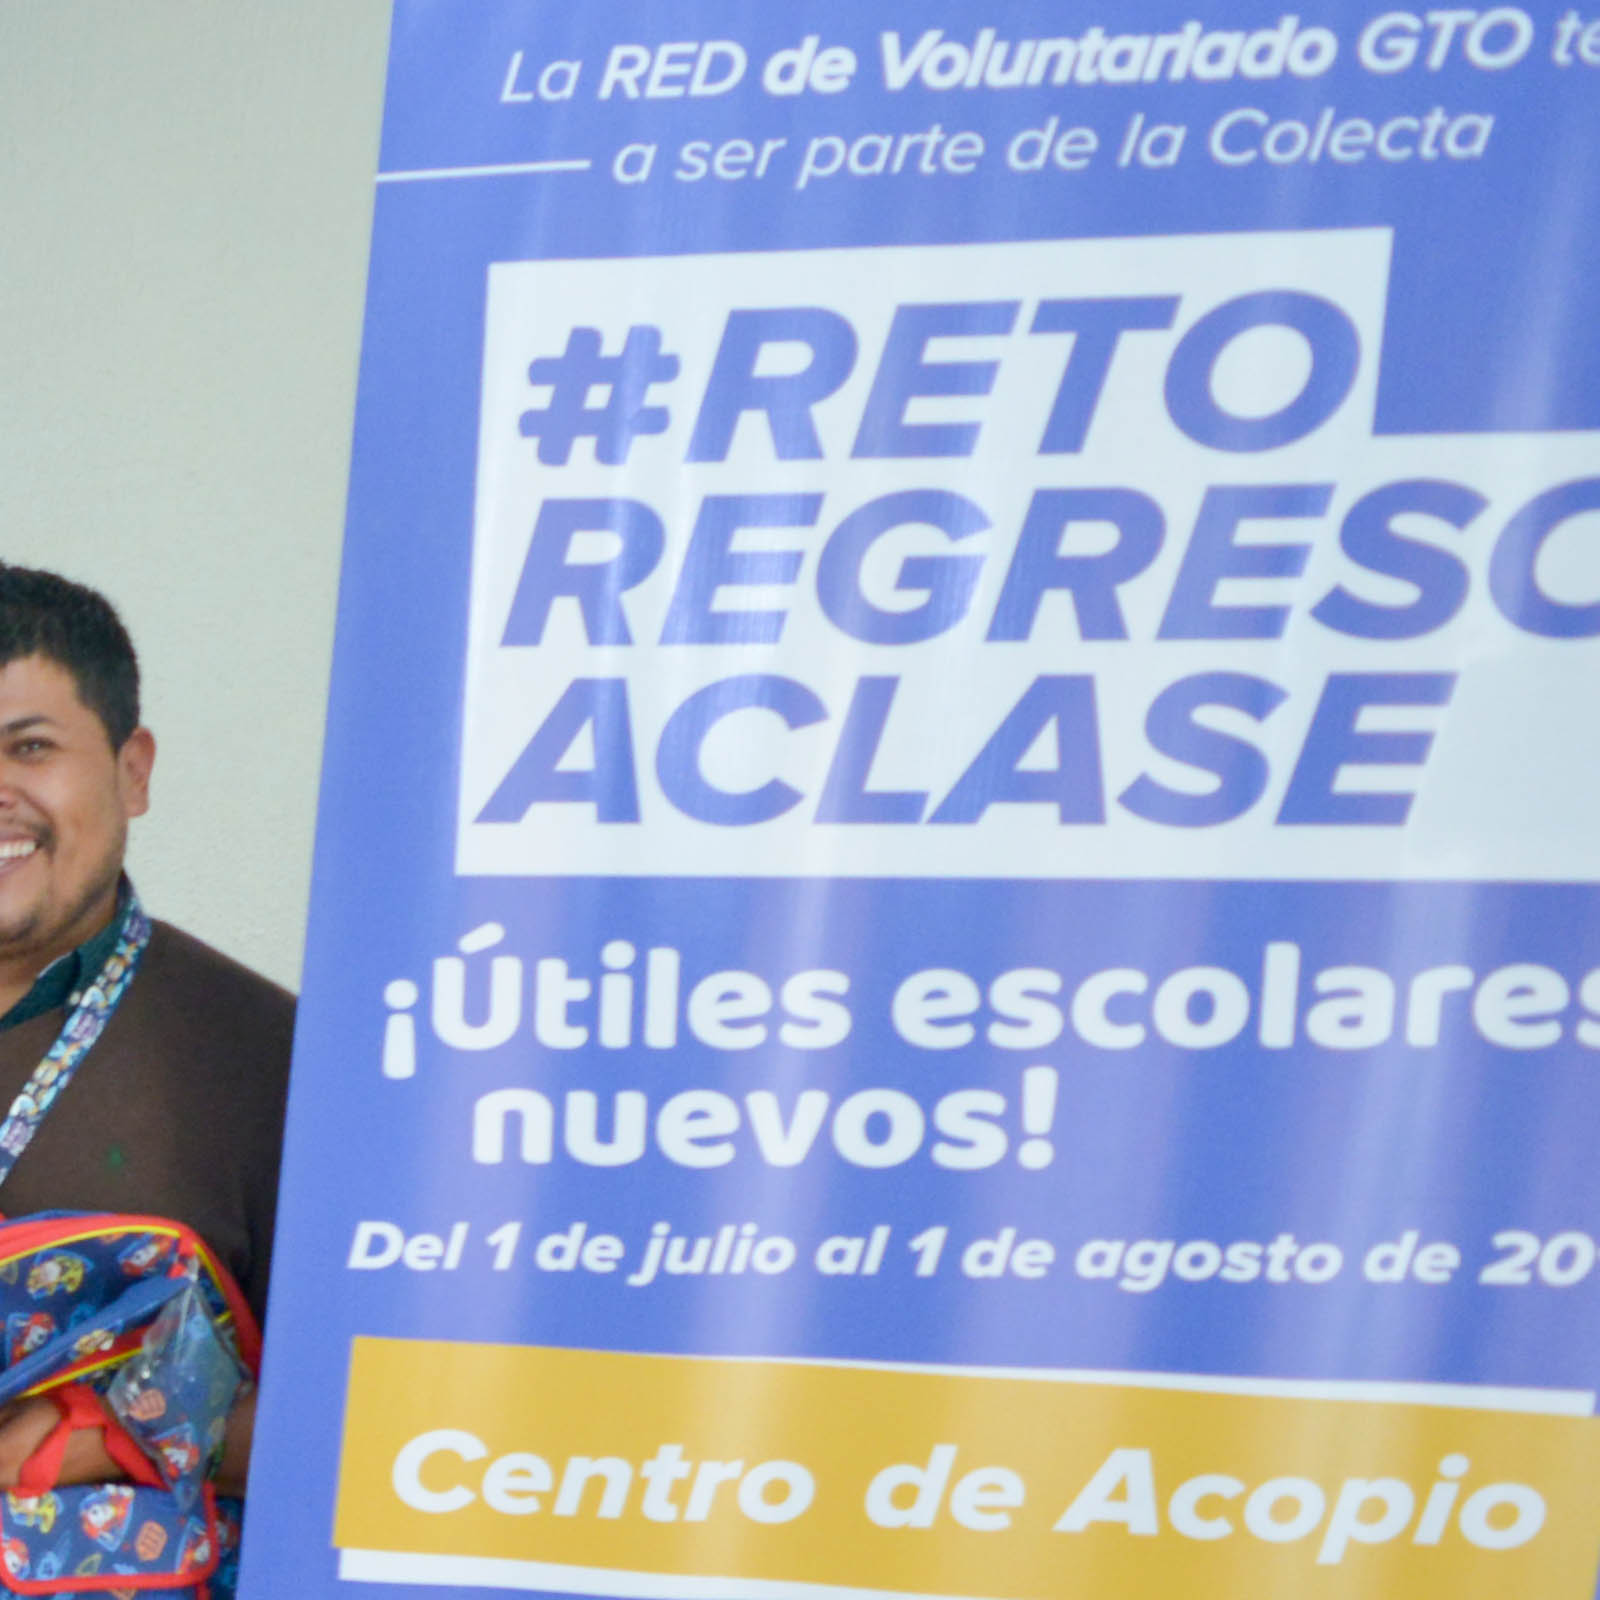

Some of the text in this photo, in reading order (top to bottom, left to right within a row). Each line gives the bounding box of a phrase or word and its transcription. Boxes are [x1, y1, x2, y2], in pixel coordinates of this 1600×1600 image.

[500, 50, 582, 103] La
[598, 39, 748, 100] RED
[762, 35, 857, 95] de
[880, 15, 1338, 91] Voluntariado
[1356, 7, 1534, 75] GTO
[612, 107, 1494, 191] a ser parte de la Colecta
[519, 289, 1361, 466] #RETO
[476, 671, 1455, 828] ACLASE
[382, 921, 852, 1080] ¡Útiles
[470, 1064, 1059, 1171] nuevos!
[347, 1220, 1600, 1294] Del 1 de julio al 1 de agosto de 20
[391, 1428, 1548, 1566] Centro de Acopio
